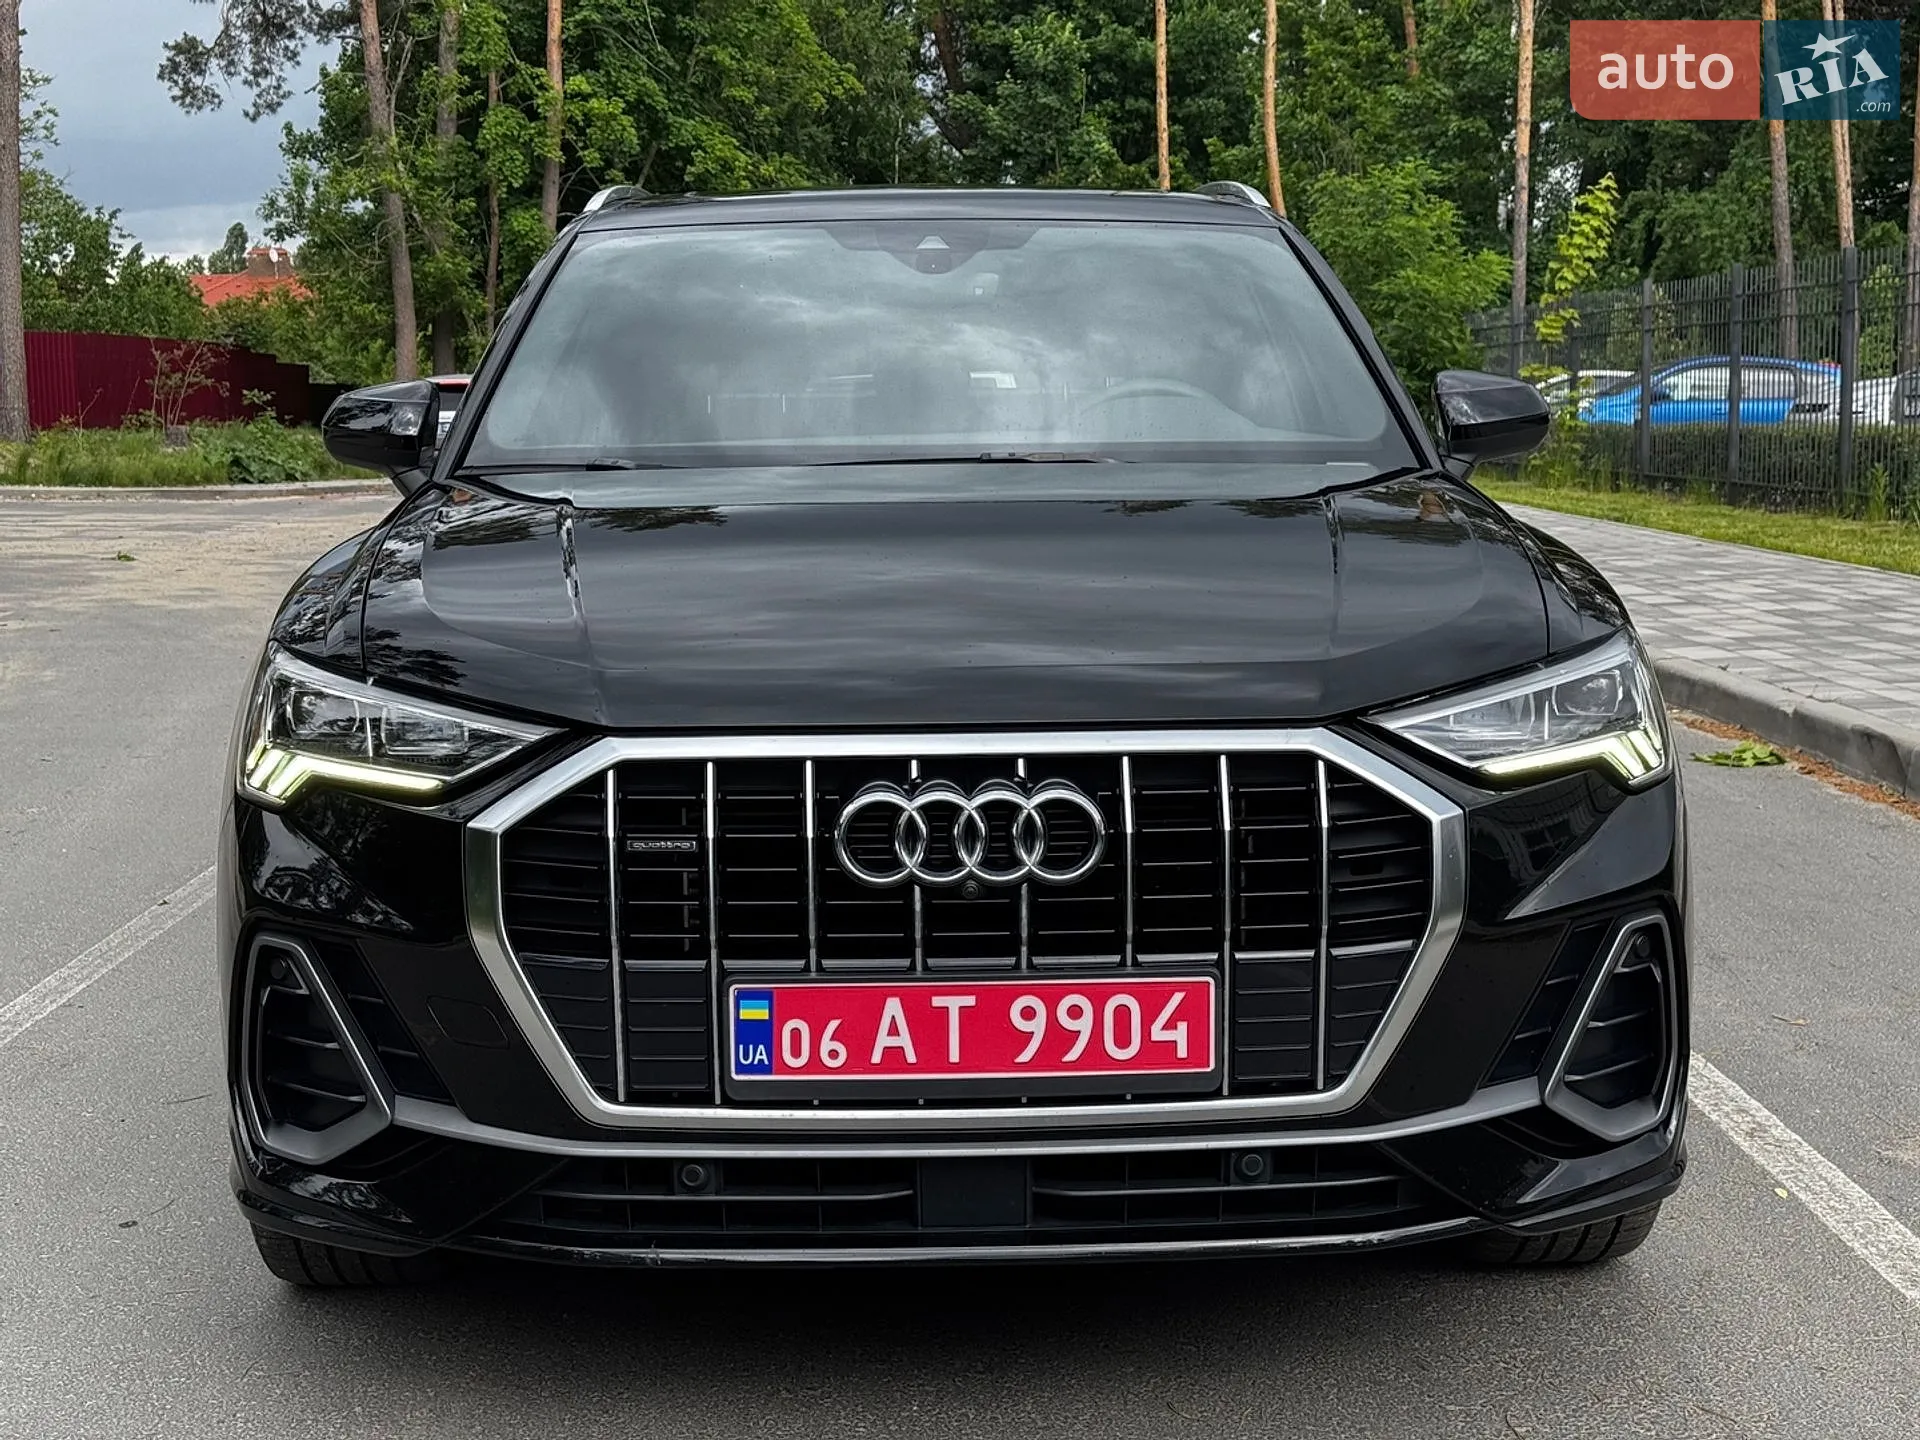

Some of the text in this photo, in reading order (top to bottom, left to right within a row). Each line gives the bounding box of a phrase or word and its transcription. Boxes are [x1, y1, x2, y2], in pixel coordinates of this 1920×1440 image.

[632, 841, 691, 850] quattro
[781, 991, 1188, 1068] 06 AT 9904
[738, 1045, 768, 1065] UA
